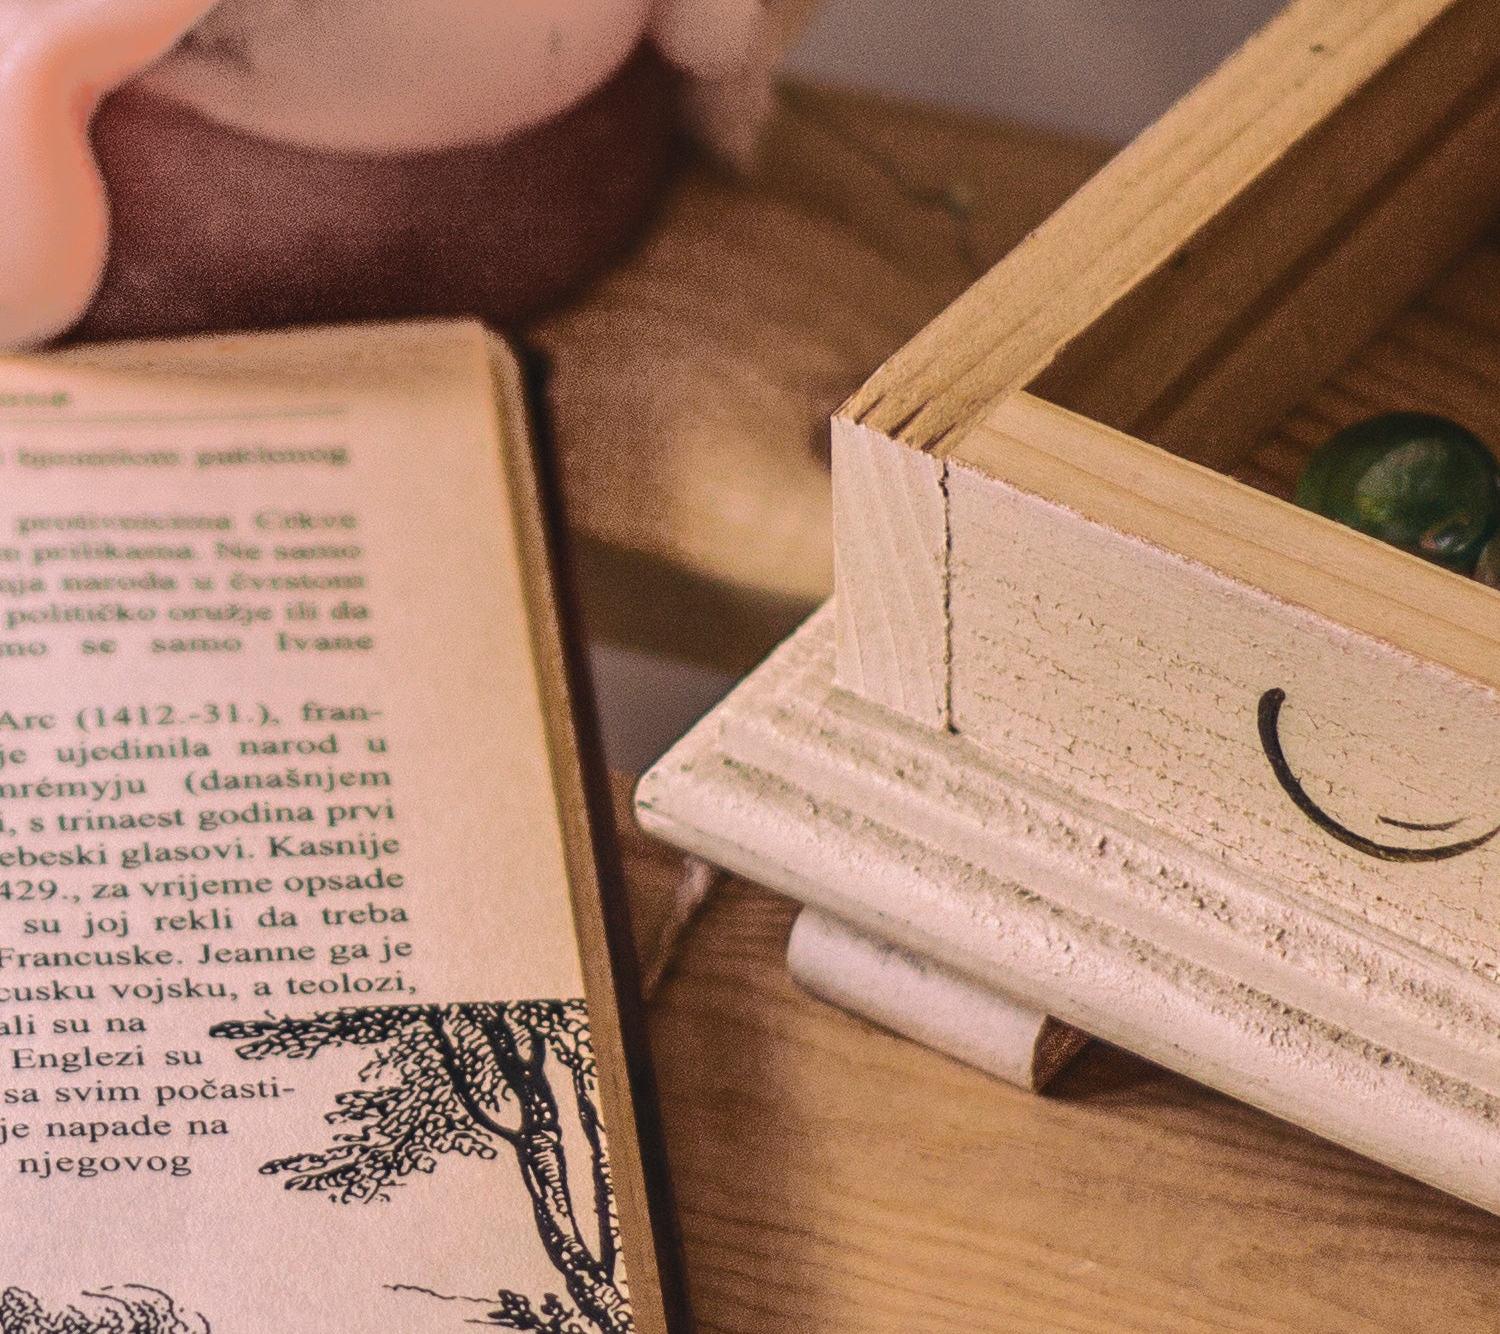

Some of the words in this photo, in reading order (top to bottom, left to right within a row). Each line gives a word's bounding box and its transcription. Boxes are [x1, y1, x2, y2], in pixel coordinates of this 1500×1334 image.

[152, 634, 242, 653] samo
[276, 632, 374, 651] Ivane
[303, 702, 383, 720] fran-
[56, 735, 209, 766] ujedinila
[240, 732, 338, 752] narod
[185, 767, 392, 794] (današnjem
[58, 807, 183, 832] trinaest
[199, 800, 314, 831] godina
[327, 799, 394, 826] prvi
[121, 837, 254, 870] glasovi.
[268, 832, 399, 864] Kasnije
[140, 871, 272, 900] vrijeme
[284, 867, 404, 896] opsade
[154, 907, 233, 932] rekli
[322, 903, 408, 927] treba
[199, 940, 317, 968] Jeanne
[110, 976, 239, 1004] vojsku,
[287, 971, 418, 1000] teolozi,
[12, 1046, 145, 1075] Englezi
[55, 1080, 139, 1105] svim
[156, 1076, 296, 1108] počasti-
[46, 1115, 172, 1144] napade
[19, 1151, 192, 1180] njegovog
